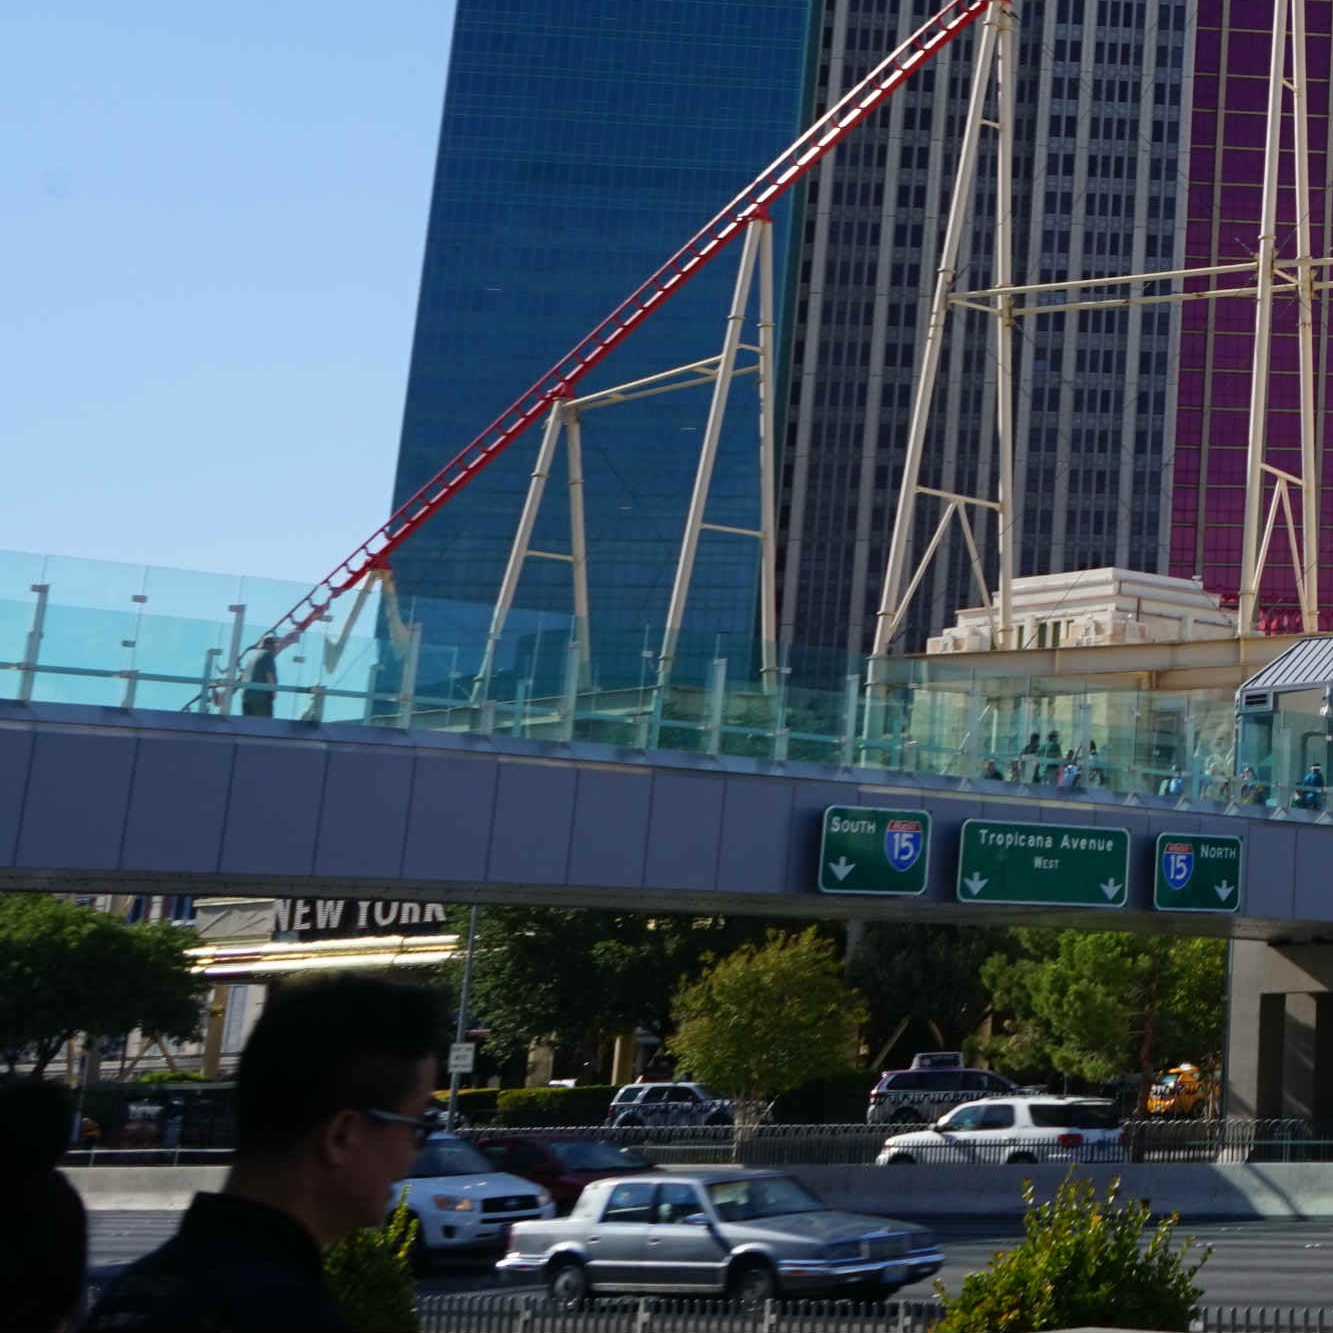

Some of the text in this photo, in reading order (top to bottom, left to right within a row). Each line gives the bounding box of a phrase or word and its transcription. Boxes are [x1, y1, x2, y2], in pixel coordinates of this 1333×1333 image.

[893, 832, 914, 861] 15
[979, 829, 1115, 852] Tropicana Avenue
[1169, 854, 1188, 881] 15
[272, 898, 346, 932] NEW
